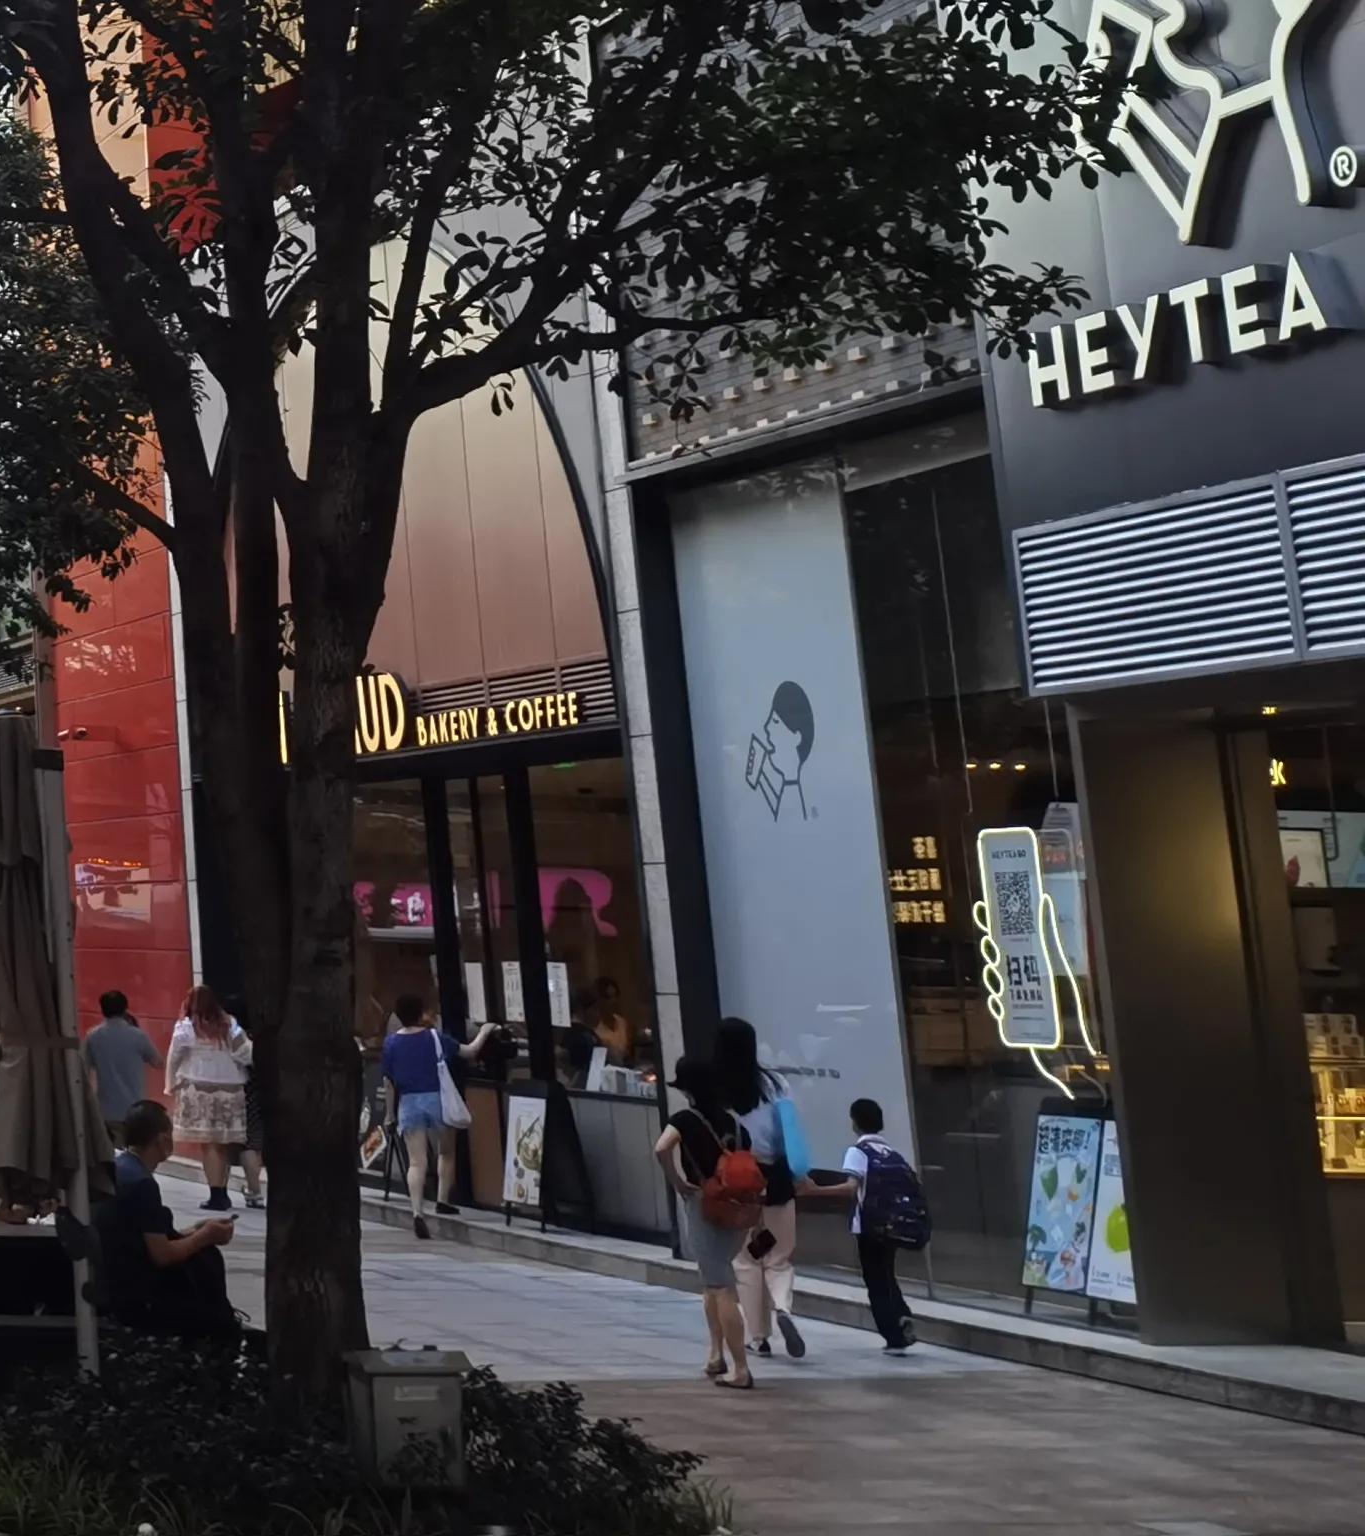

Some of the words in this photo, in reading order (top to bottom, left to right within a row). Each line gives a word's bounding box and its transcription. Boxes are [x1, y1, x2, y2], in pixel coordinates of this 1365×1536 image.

[1028, 252, 1328, 408] HEYTEA
[417, 707, 479, 746] BAKERY
[505, 692, 578, 733] COFFEE
